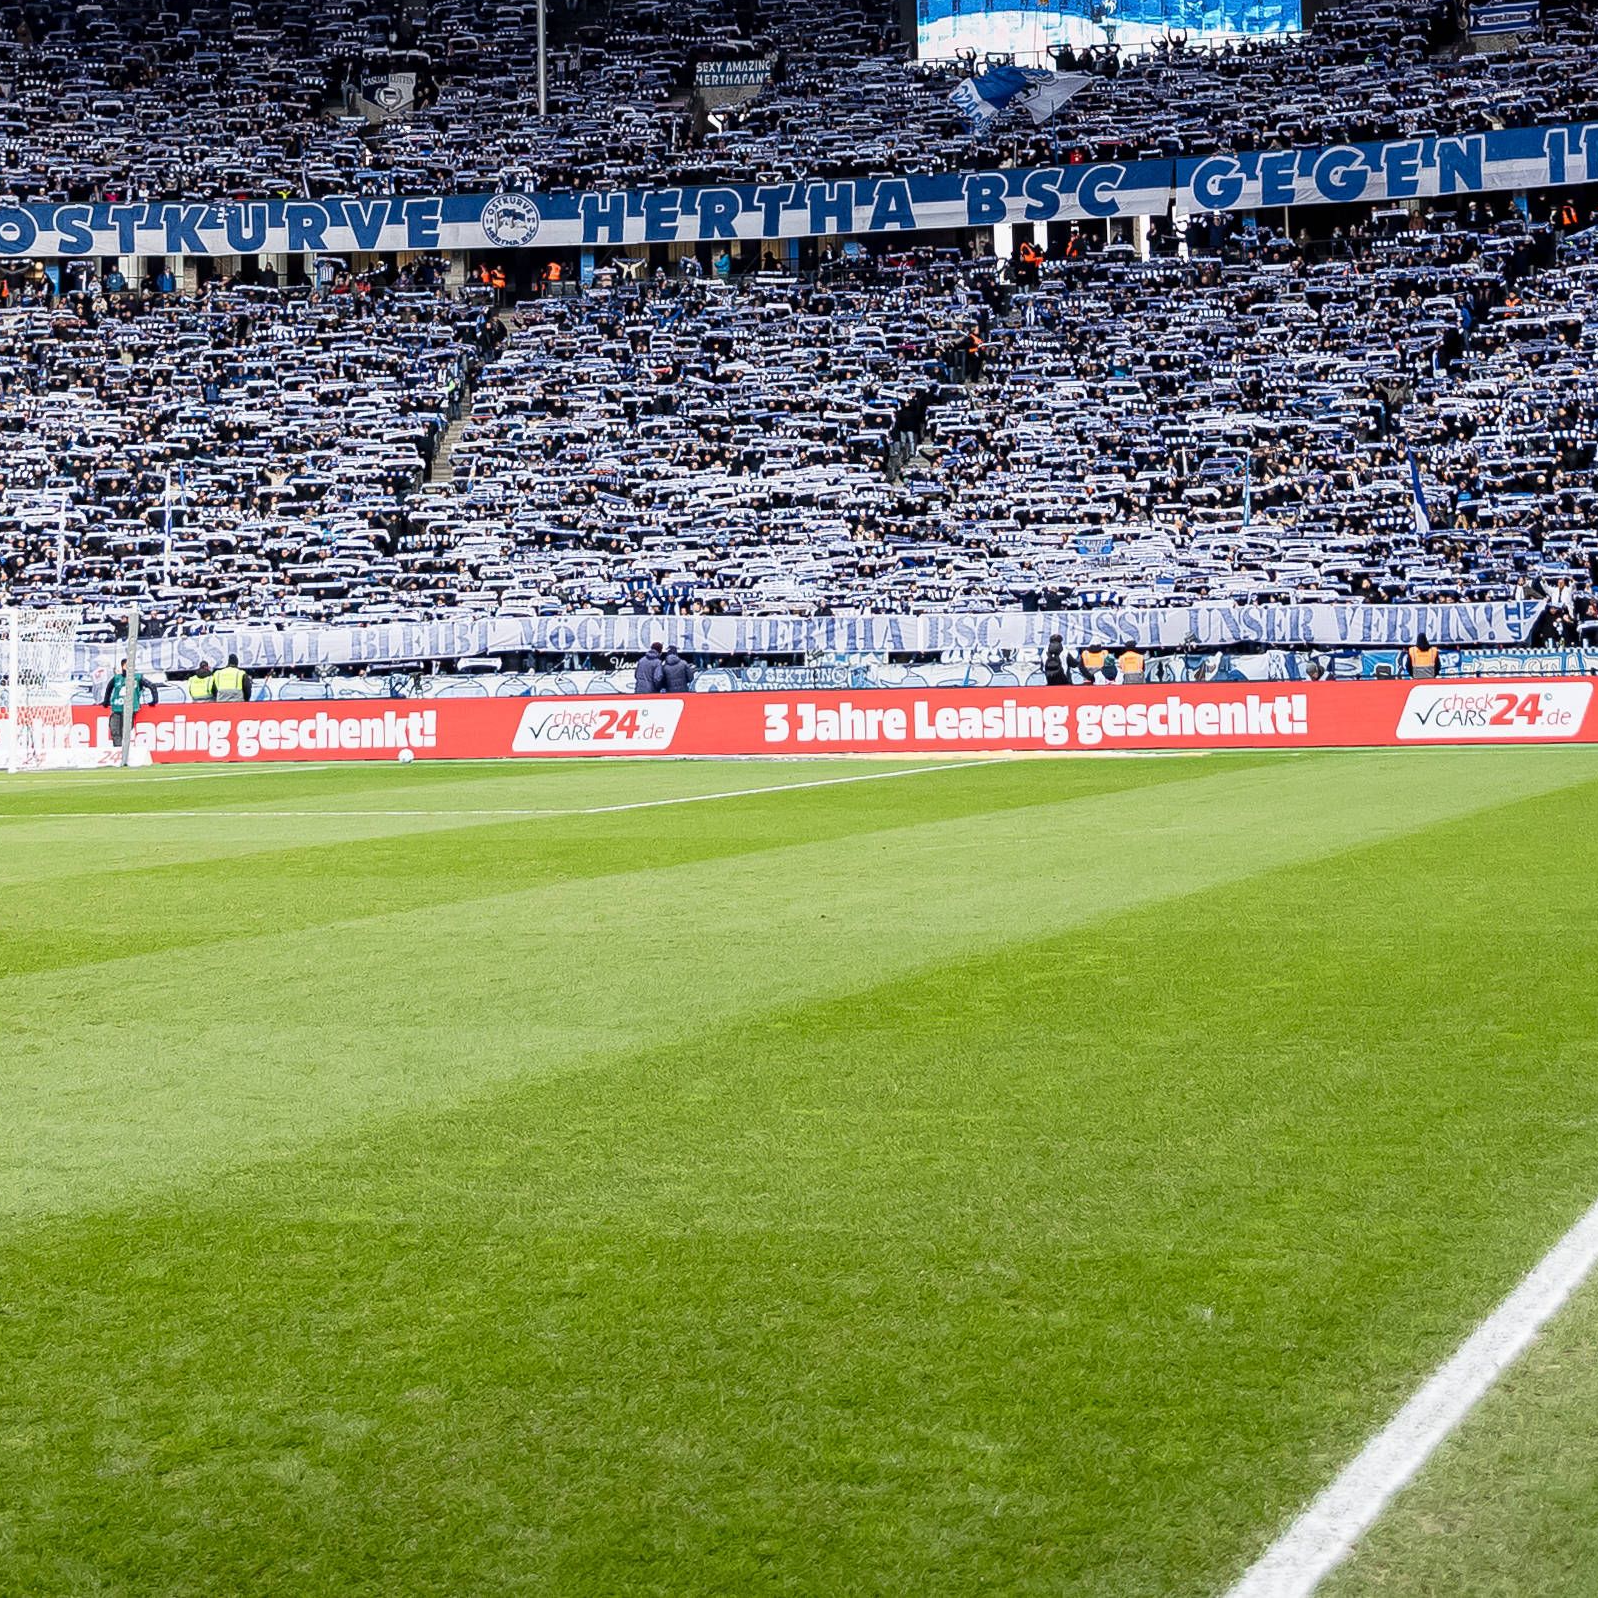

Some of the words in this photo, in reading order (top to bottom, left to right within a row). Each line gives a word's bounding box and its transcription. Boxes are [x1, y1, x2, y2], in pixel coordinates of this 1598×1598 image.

[696, 61, 723, 73] SEXY
[725, 60, 771, 72] AMAZING
[487, 196, 534, 215] OSTKURVE
[579, 179, 918, 243] HERTHA
[963, 164, 1126, 226] BSC
[1193, 134, 1486, 209] GEGEN
[350, 620, 495, 659] BLEIBT
[519, 615, 712, 650] MÖGLICH!
[735, 615, 903, 652] HERTHA
[927, 614, 1001, 650] BSC
[1024, 610, 1168, 648] HEISST
[1186, 605, 1314, 644] UNSER
[1335, 603, 1496, 643] VEREIN!
[554, 708, 597, 725] check
[593, 710, 640, 739] 24
[764, 704, 789, 742] 3
[796, 702, 907, 741] Jahre
[914, 699, 1069, 745] Leasing
[1076, 693, 1308, 745] geschenkt!
[1442, 693, 1494, 710] check
[1489, 693, 1543, 725] 24
[236, 710, 436, 757] geschenkt!
